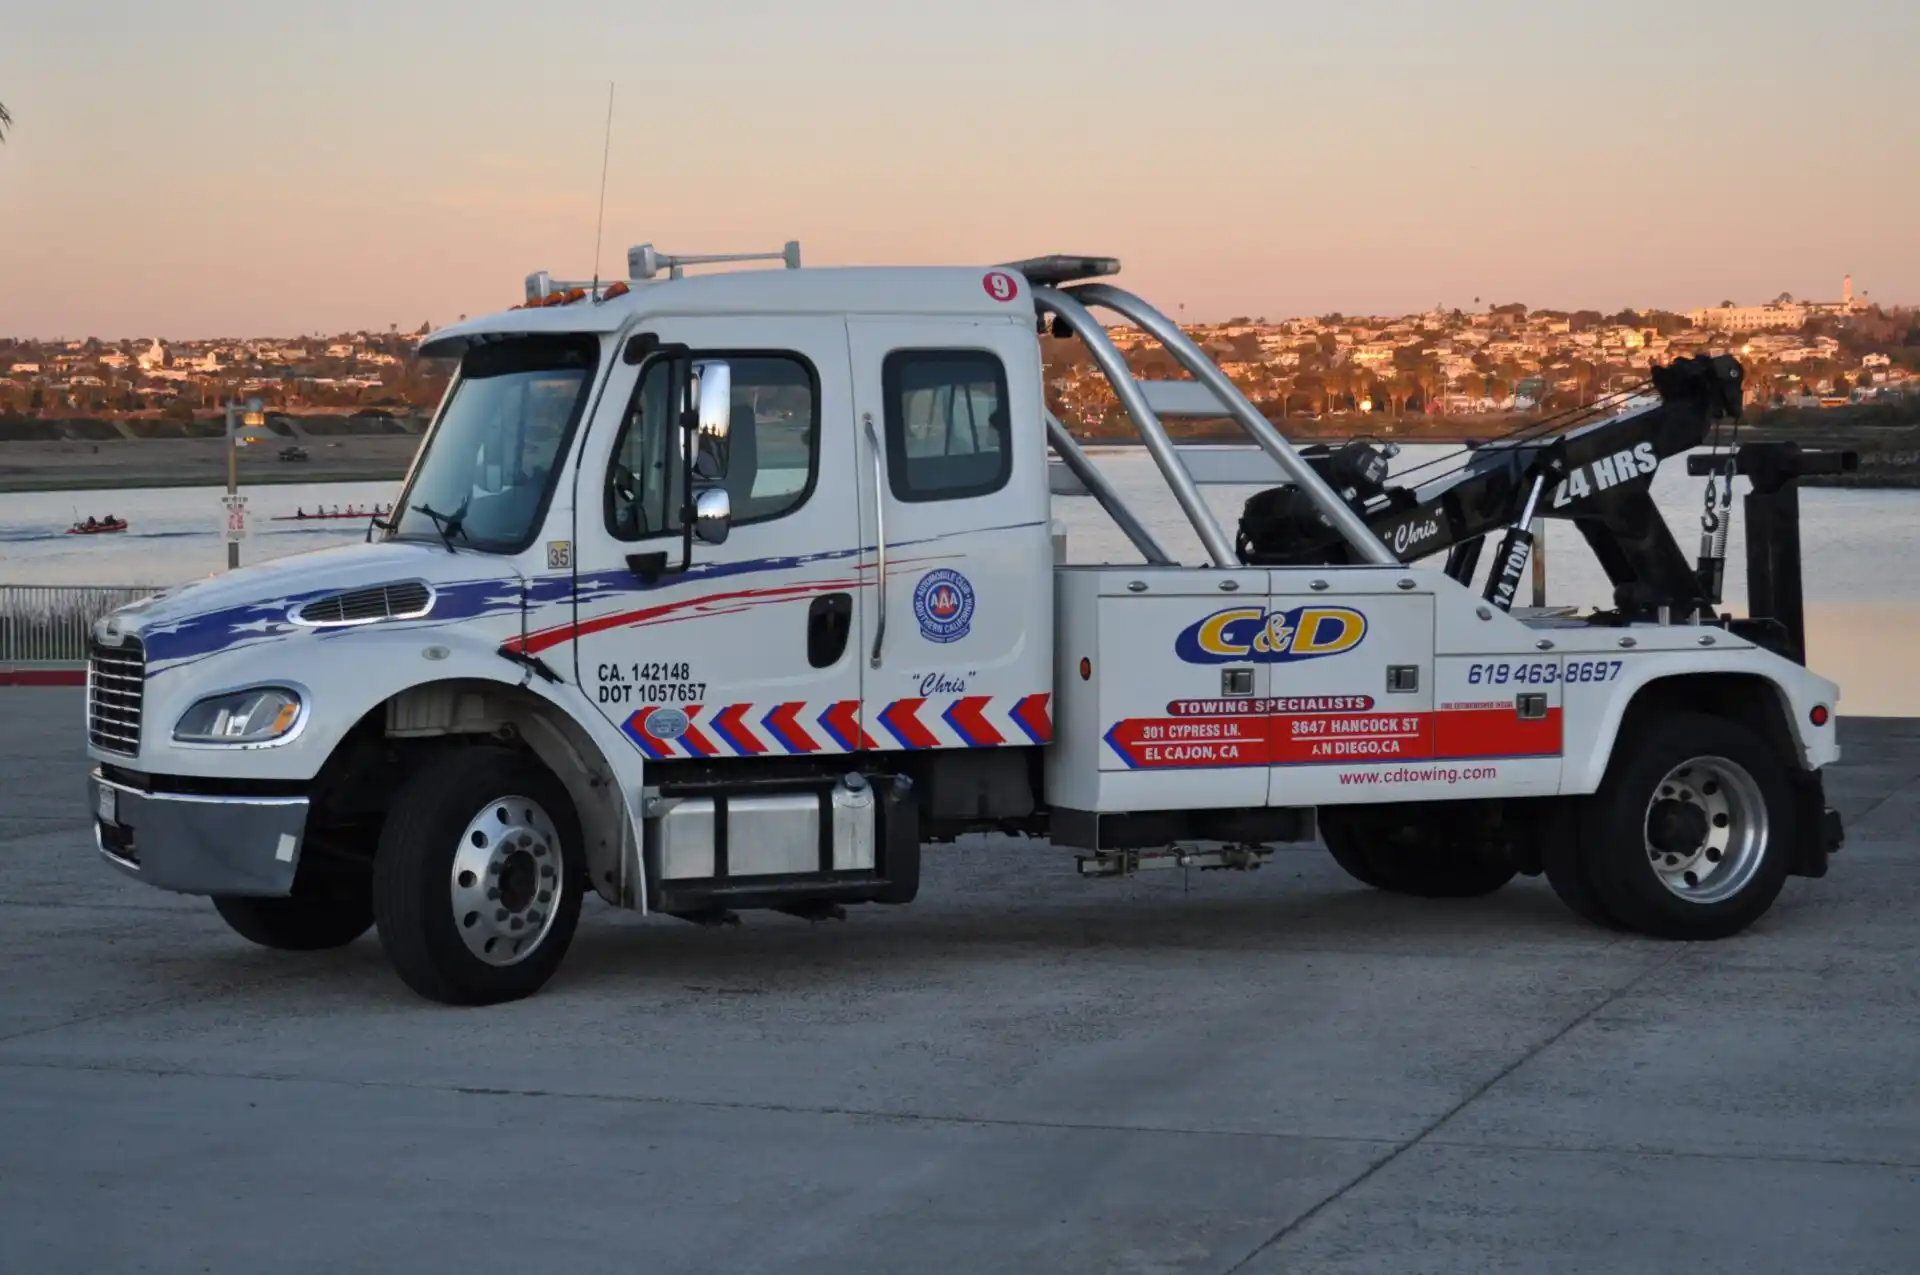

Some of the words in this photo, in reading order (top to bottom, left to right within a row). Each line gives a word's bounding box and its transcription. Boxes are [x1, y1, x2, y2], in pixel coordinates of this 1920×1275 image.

[991, 275, 1009, 298] 9
[1591, 442, 1657, 492] HRS
[550, 548, 569, 567] 35
[1502, 540, 1529, 578] TON
[930, 591, 958, 609] AAA
[1493, 582, 1514, 606] 14
[1197, 607, 1366, 656] C&D
[598, 663, 625, 682] CA.
[632, 662, 690, 681] 142148
[1468, 664, 1510, 684] 619
[599, 684, 633, 703] DOT
[638, 683, 707, 702] 1057657
[1178, 701, 1249, 714] TOWING
[1255, 696, 1366, 712] SPECIALISTS
[1143, 725, 1165, 739] 301
[1168, 724, 1221, 738] CYPRESS
[1224, 723, 1241, 737] LN.
[1291, 720, 1327, 735] 3647
[1331, 719, 1398, 733] HANCOCK
[1402, 718, 1420, 731] ST
[1145, 747, 1162, 761] EL
[1165, 746, 1217, 760] CAJON,
[1220, 745, 1239, 759] CA
[1311, 742, 1332, 755] AN
[1339, 766, 1497, 785] www.cdtowing.com
